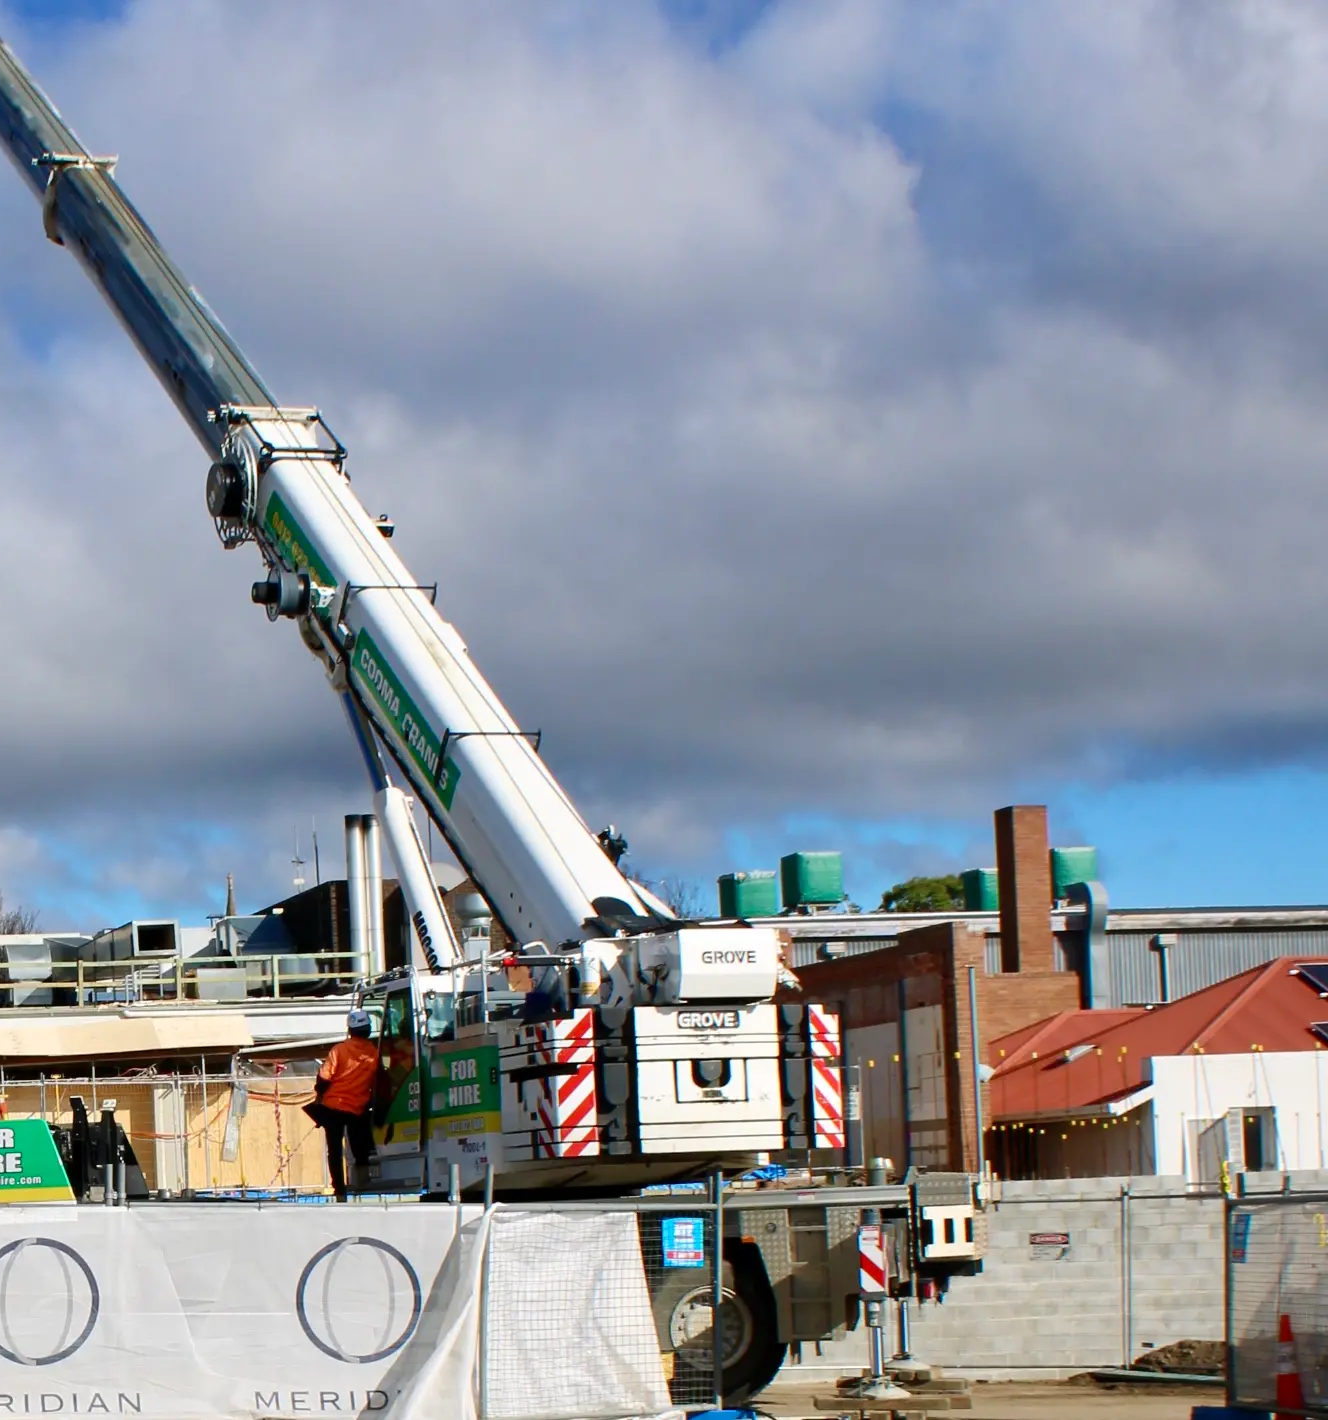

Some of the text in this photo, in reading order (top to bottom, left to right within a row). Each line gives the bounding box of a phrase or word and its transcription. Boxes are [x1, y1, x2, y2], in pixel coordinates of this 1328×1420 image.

[360, 648, 400, 717] COOMA
[701, 950, 757, 964] GROVE
[678, 1011, 736, 1028] GROVE
[451, 1058, 477, 1082] FOR
[448, 1084, 482, 1108] HIRE
[254, 1389, 402, 1411] MERID
